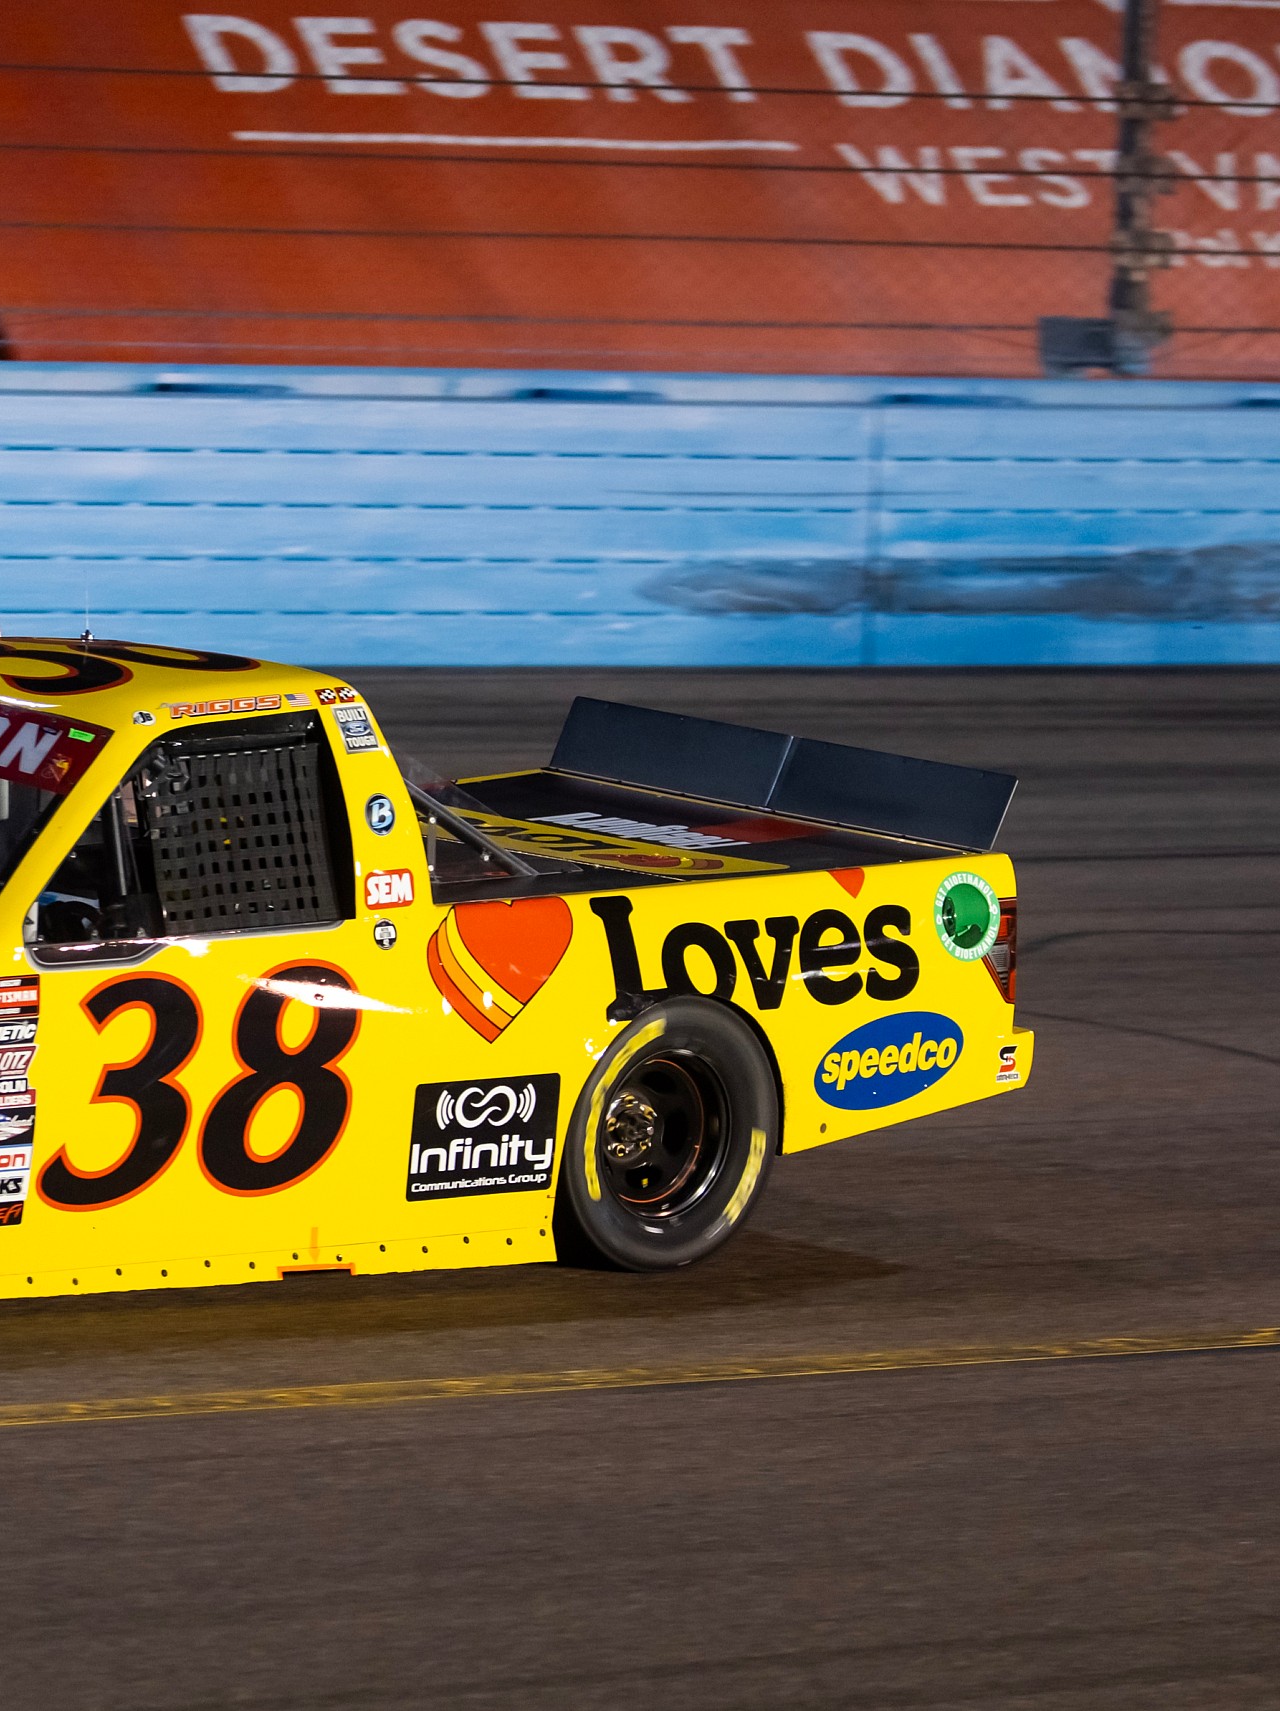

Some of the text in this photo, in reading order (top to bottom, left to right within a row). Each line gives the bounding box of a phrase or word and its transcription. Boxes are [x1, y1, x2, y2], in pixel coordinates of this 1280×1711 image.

[183, 13, 1280, 117] DESERT DIAMO
[170, 694, 282, 719] RIGGS
[336, 707, 367, 723] BUILT
[345, 736, 376, 748] TOUGH
[366, 872, 414, 905] SEM
[589, 895, 920, 1022] Loves
[820, 1031, 958, 1091] speedco
[36, 958, 363, 1213] 38
[410, 1134, 554, 1175] Infinity
[411, 1173, 547, 1192] Communications Group
